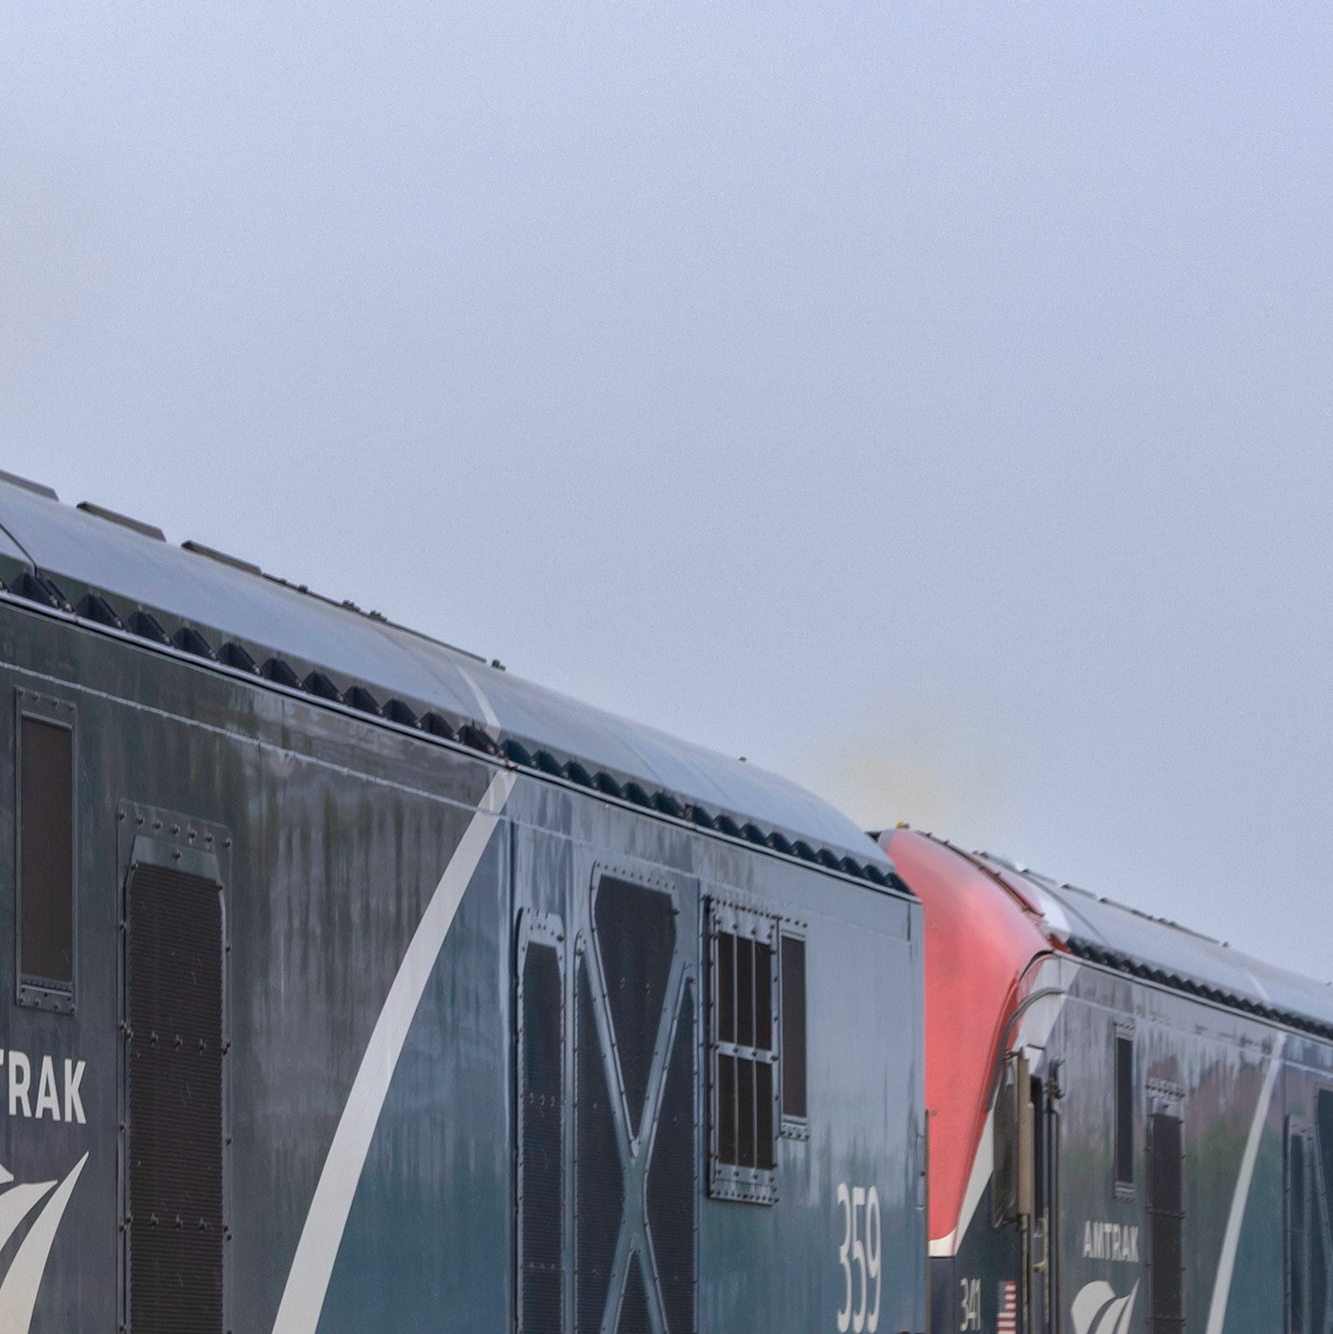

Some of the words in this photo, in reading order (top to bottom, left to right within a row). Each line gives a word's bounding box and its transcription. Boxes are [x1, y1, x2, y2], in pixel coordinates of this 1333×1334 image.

[836, 1182, 881, 1334] 359
[1082, 1220, 1140, 1262] AMTRAK
[960, 1277, 981, 1332] 341
